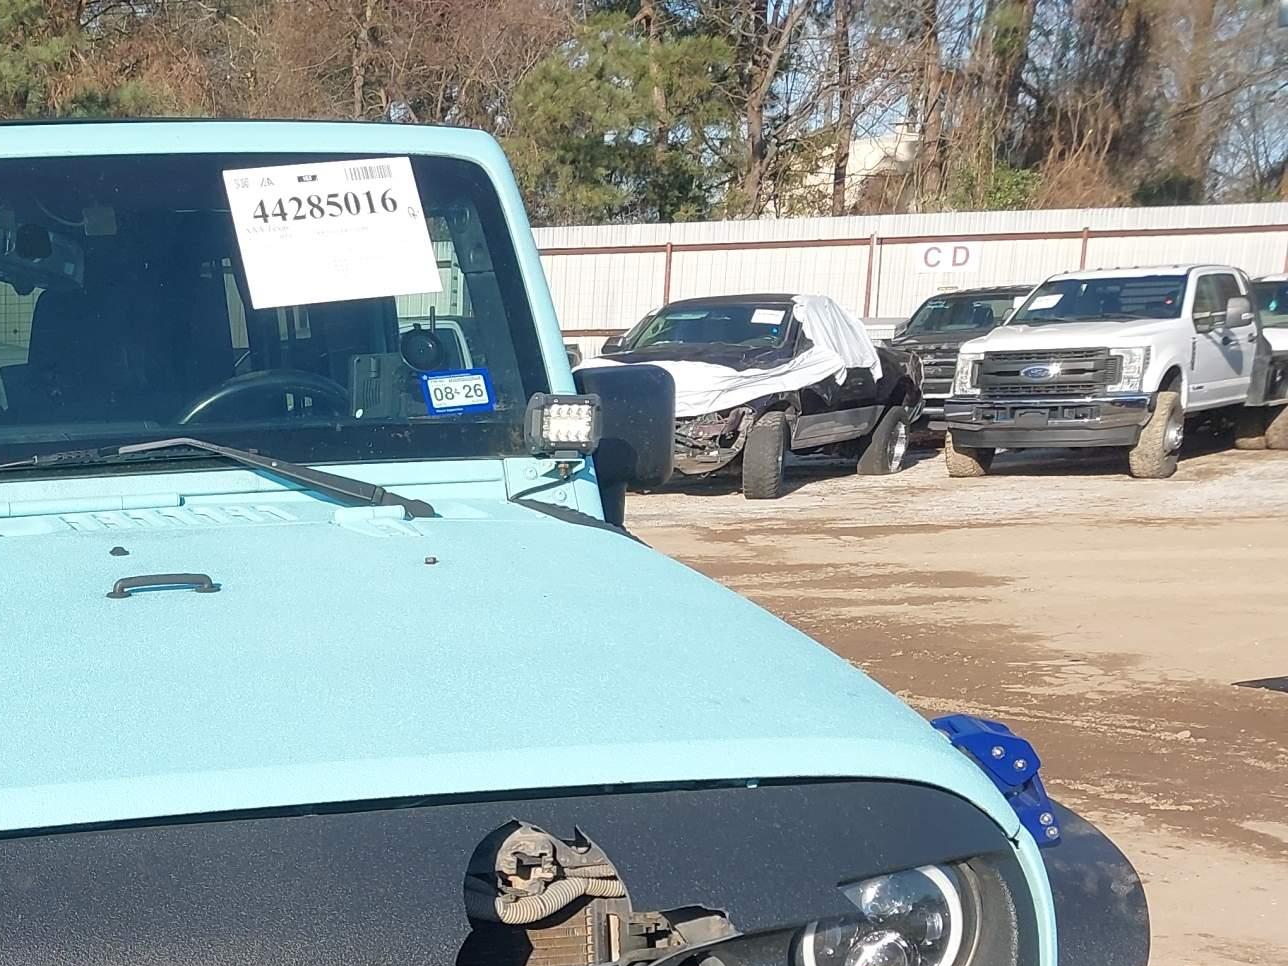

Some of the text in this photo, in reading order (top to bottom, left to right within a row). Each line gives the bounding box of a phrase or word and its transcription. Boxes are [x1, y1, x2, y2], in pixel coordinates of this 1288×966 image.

[253, 188, 398, 224] 44285016
[923, 245, 970, 268] C D
[462, 383, 484, 398] 26
